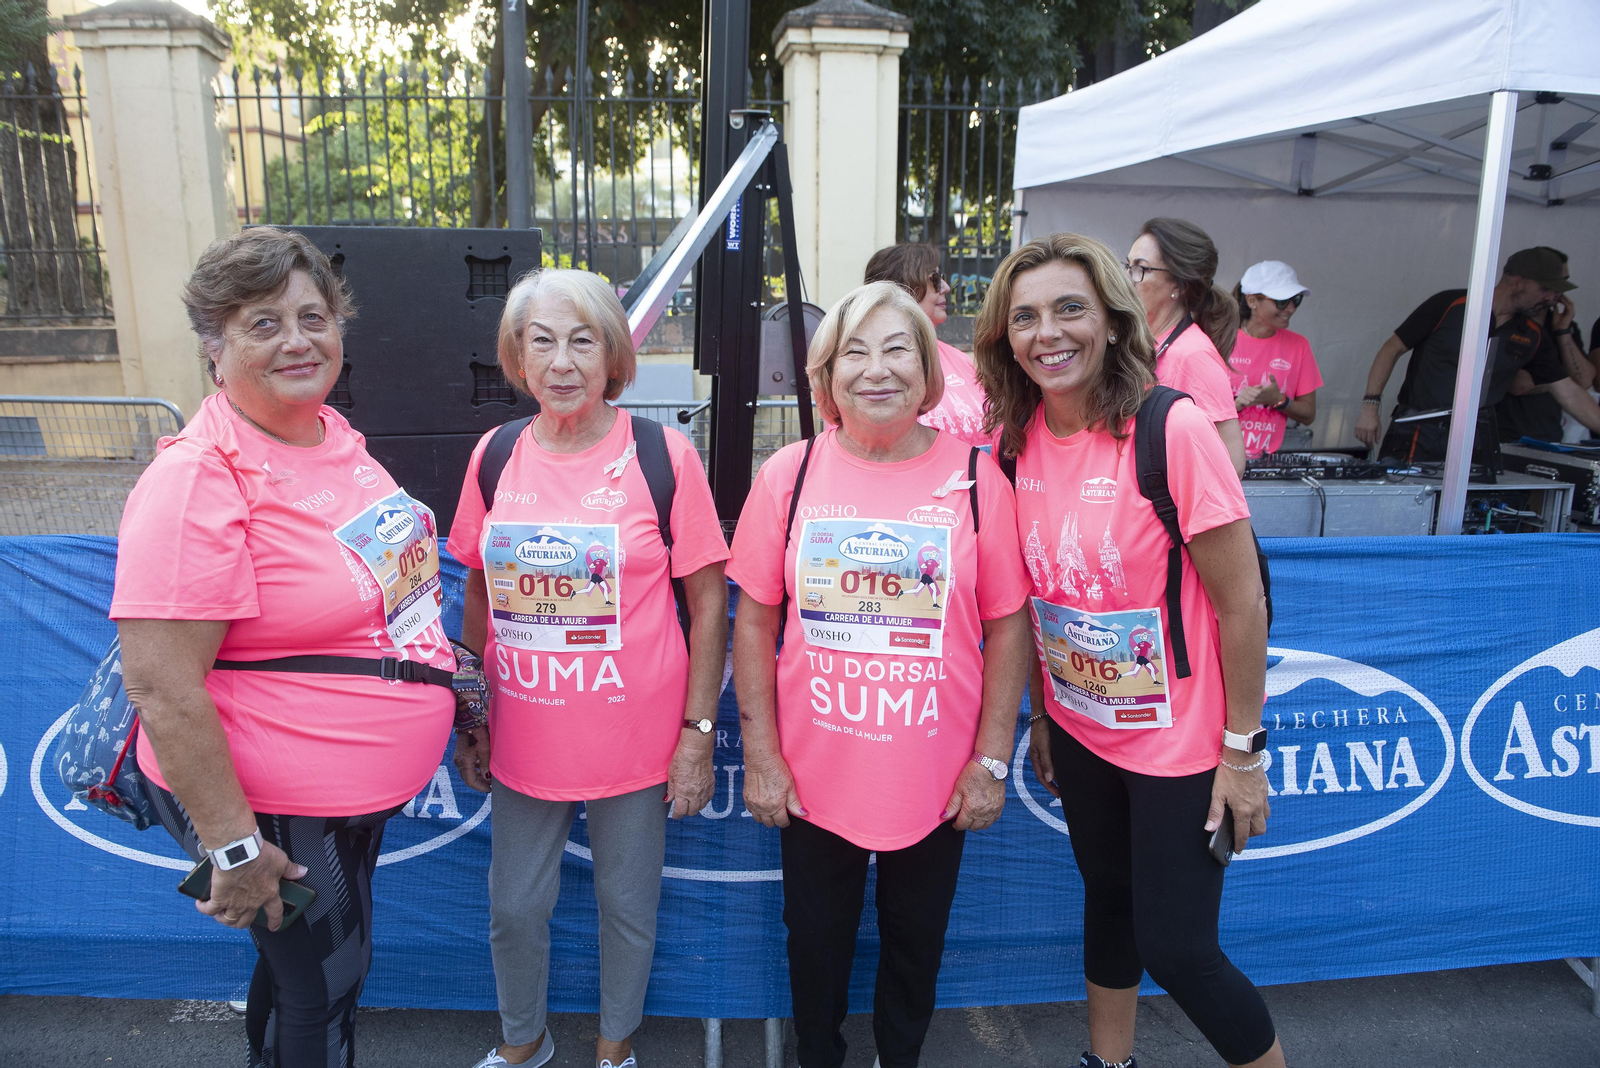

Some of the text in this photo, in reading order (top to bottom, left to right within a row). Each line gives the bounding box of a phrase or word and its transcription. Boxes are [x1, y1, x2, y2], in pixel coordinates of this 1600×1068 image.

[1081, 485, 1116, 497] ASTURIAN
[800, 504, 858, 519] OYSHO
[378, 516, 414, 543] ASTURIANA
[491, 540, 511, 549] SUMA
[810, 536, 833, 544] SUMA
[518, 545, 573, 560] ASTURIANA
[843, 541, 904, 558] ASTURIANA
[398, 540, 426, 578] 016
[409, 572, 422, 590] 284
[518, 573, 574, 598] 016
[840, 570, 902, 597] 016
[398, 593, 416, 613] CARRERA
[414, 588, 422, 599] DE
[420, 584, 428, 594] LA
[858, 600, 881, 613] 283
[535, 602, 557, 614] 279
[394, 612, 421, 639] OYSHO
[511, 613, 588, 625] CARRERA DE LA MUJER
[824, 612, 913, 626] CARRERA DE LA MUJER
[500, 627, 533, 642] OYSHO
[810, 627, 852, 642] OYSHO
[900, 636, 926, 644] Santander
[1067, 625, 1116, 647] ASTURIANA
[495, 643, 625, 692] SUMA
[805, 650, 947, 683] TU DORSAL
[1070, 651, 1119, 681] 016
[1066, 682, 1137, 705] CARRERA DE LA MUJER
[1083, 679, 1107, 695] 1240
[518, 692, 528, 701] DE
[528, 694, 537, 703] LA
[538, 697, 566, 706] MUJER
[607, 694, 626, 704] 2022
[809, 676, 939, 727] SUMA
[1273, 706, 1408, 731] LECHERA
[812, 717, 893, 742] CARRERA DE LA MUJER
[1265, 736, 1425, 797] RIANA
